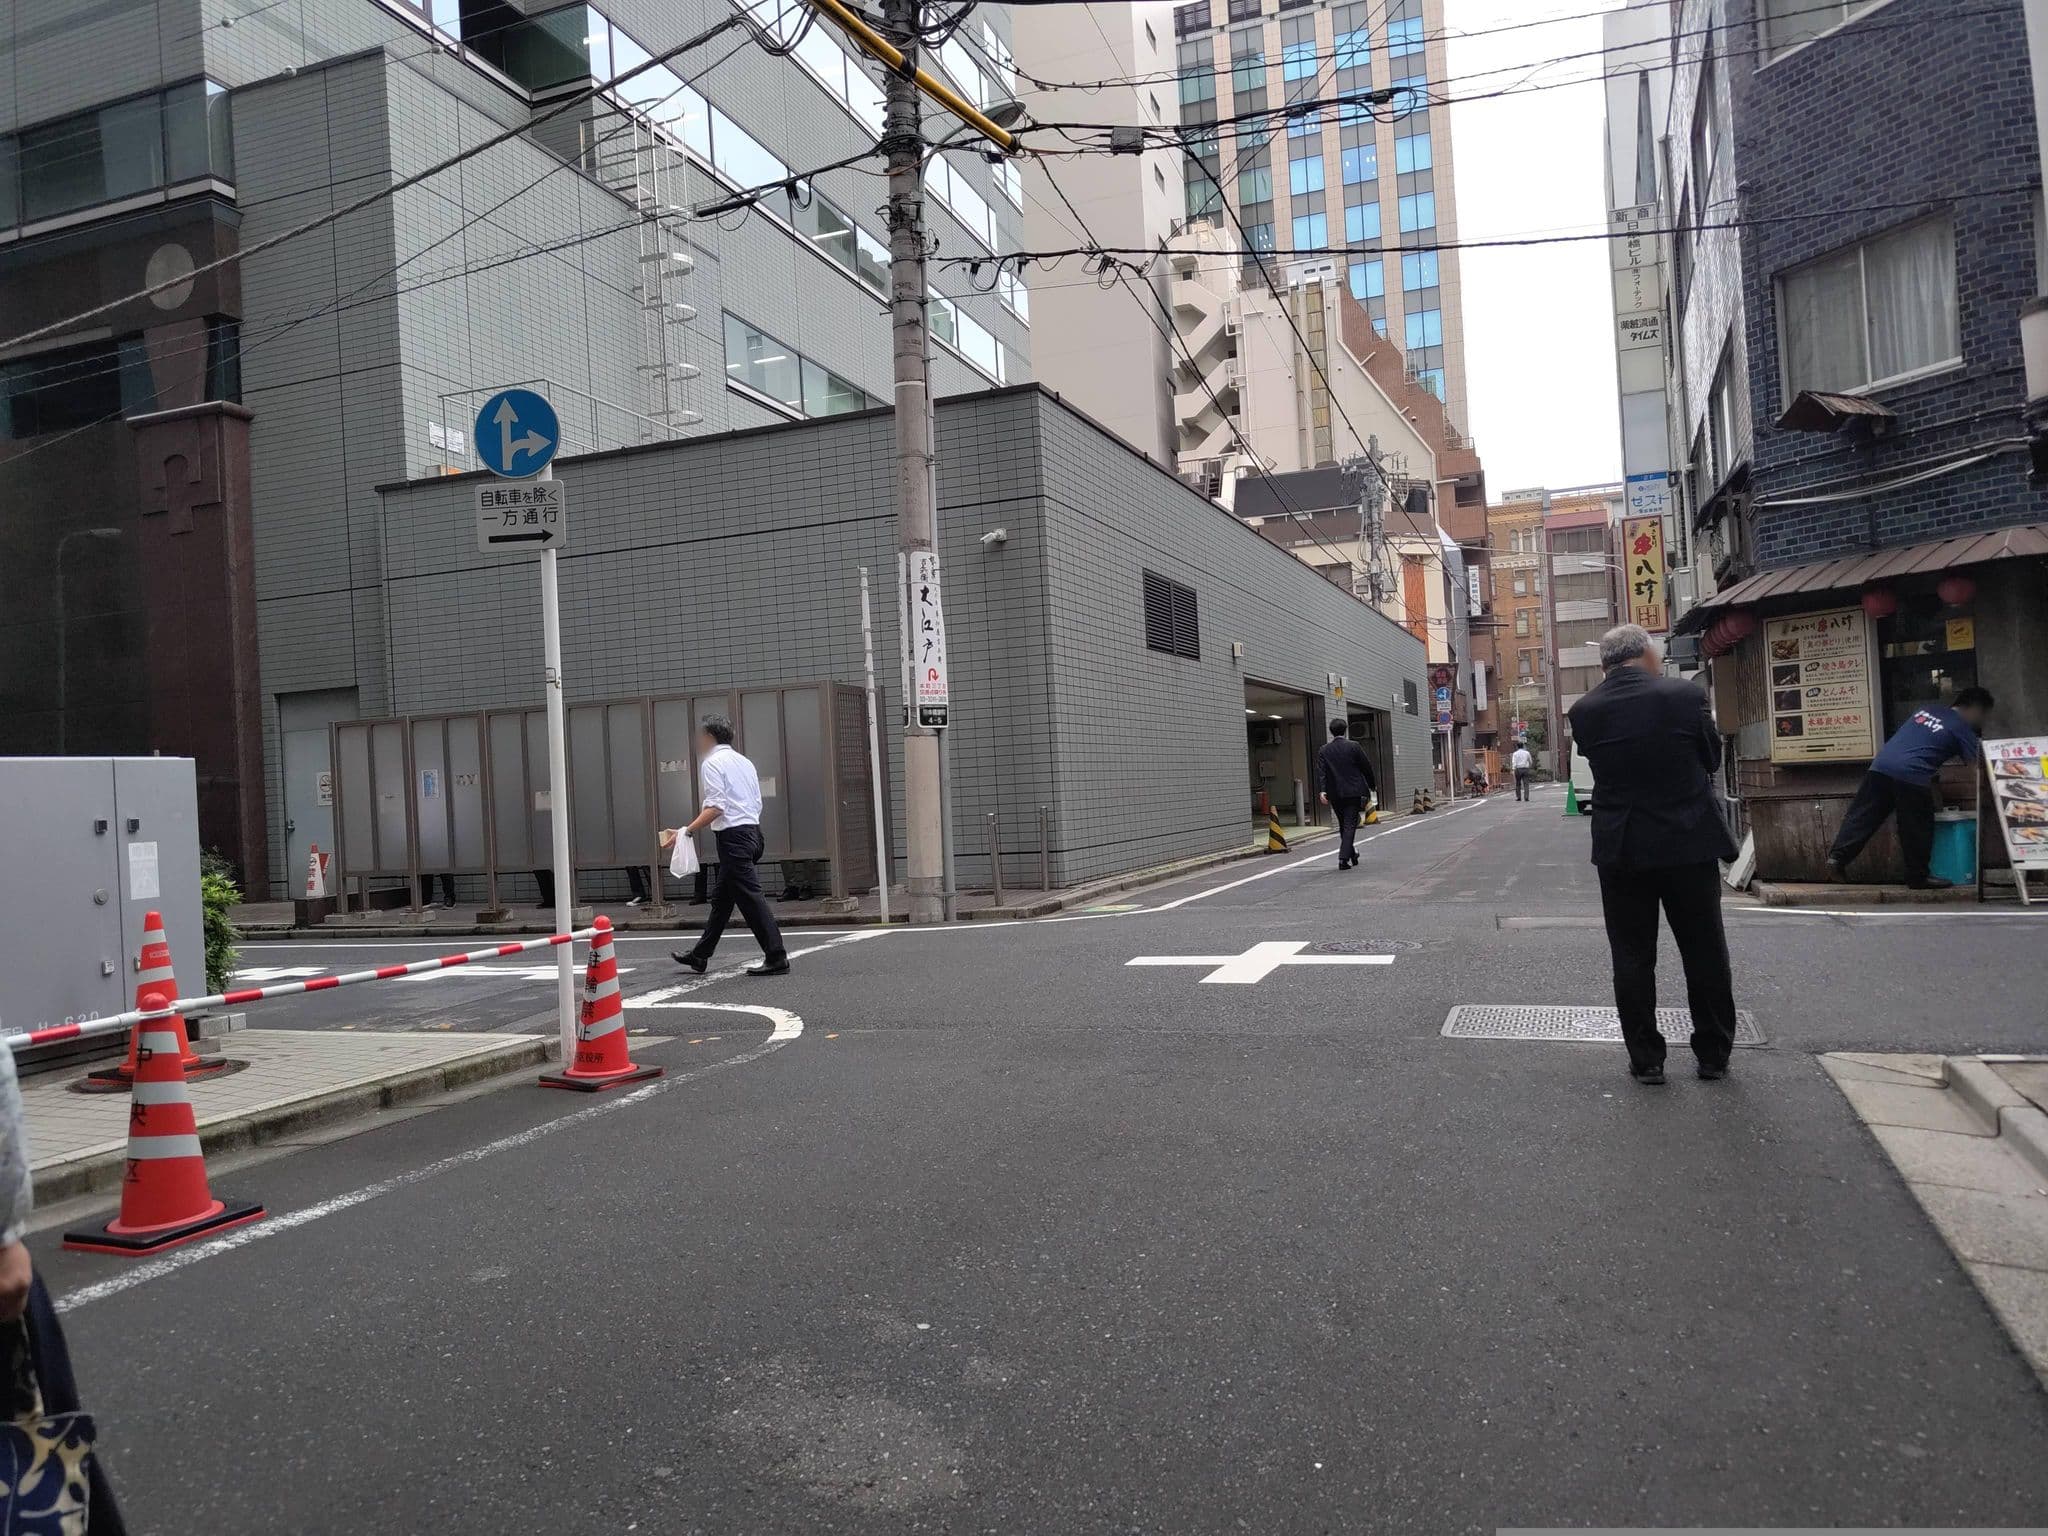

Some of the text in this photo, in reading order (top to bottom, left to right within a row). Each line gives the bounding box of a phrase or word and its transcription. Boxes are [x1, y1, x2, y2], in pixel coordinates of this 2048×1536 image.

[1630, 329, 1660, 342] タイムズ
[481, 487, 558, 507] 自転車を除く
[482, 506, 559, 526] 一方通行
